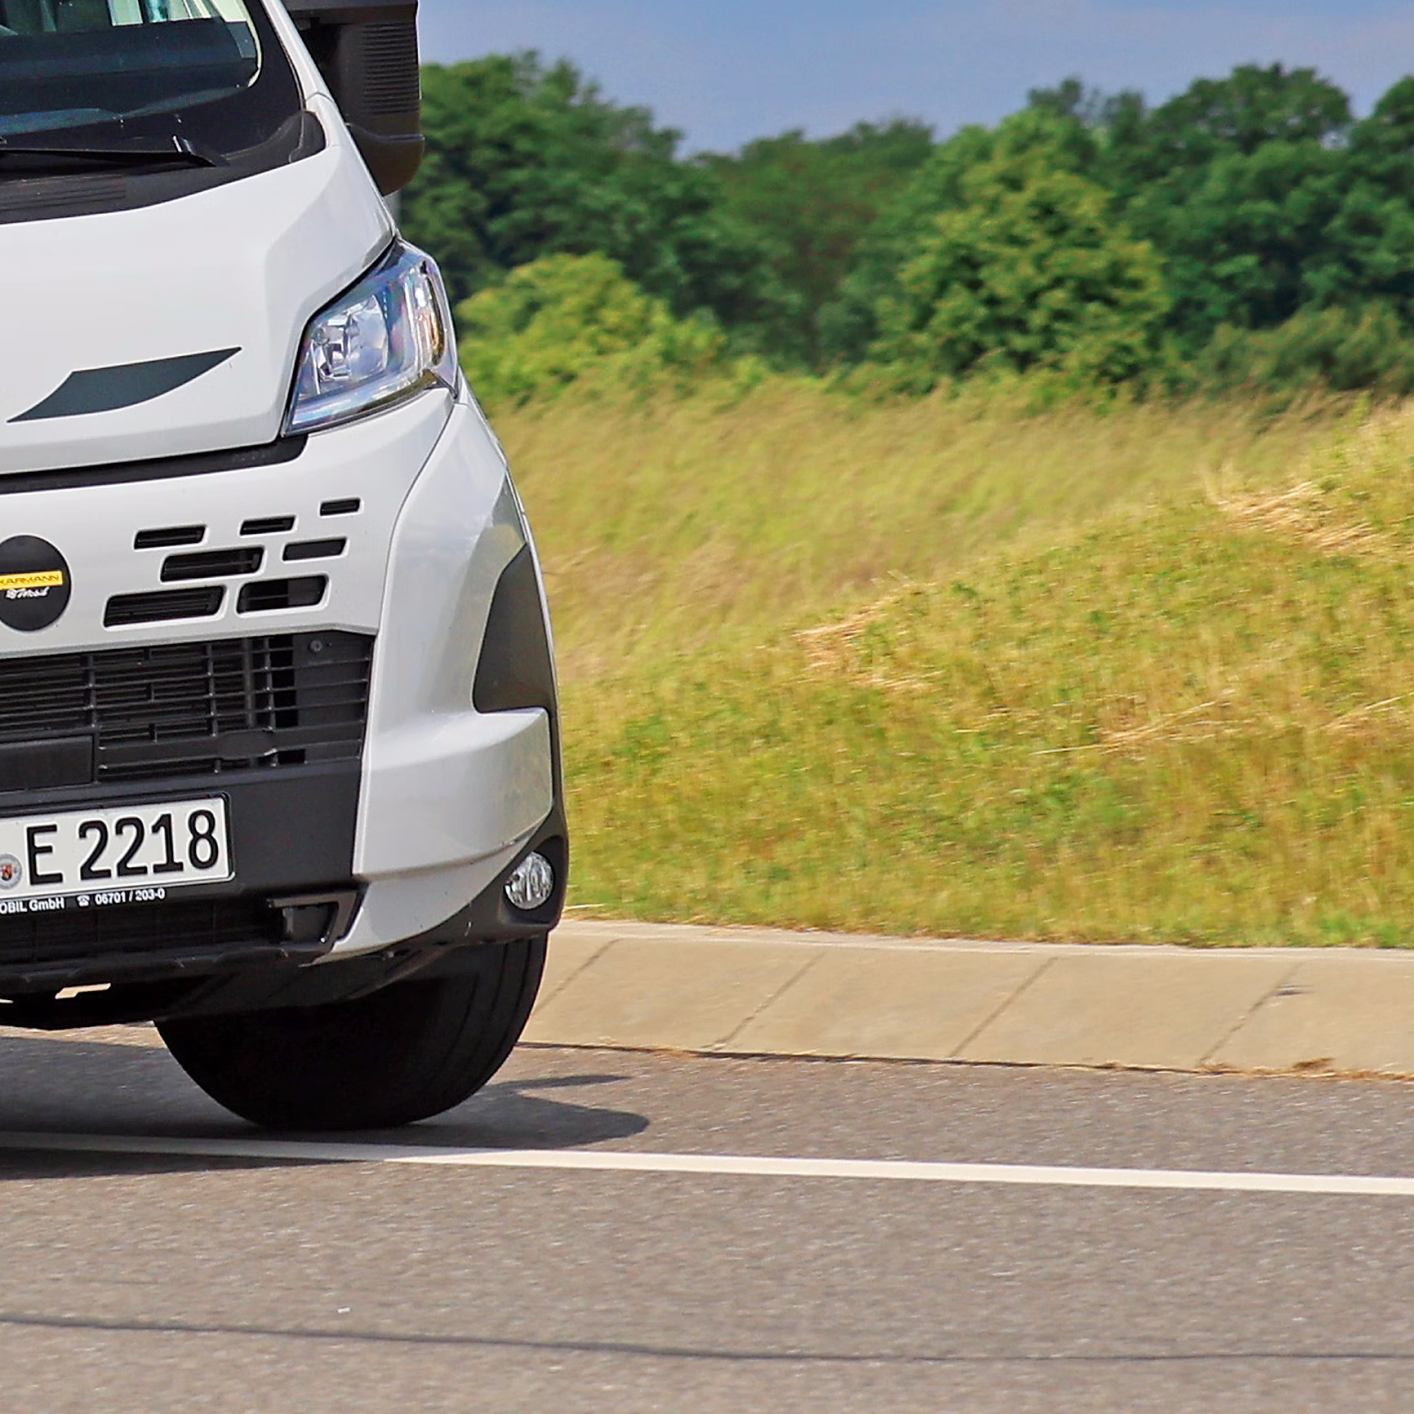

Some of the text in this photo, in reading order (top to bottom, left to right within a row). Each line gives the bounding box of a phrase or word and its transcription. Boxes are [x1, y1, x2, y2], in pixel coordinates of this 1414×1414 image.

[26, 824, 64, 886] E
[78, 809, 219, 881] 2218
[29, 897, 65, 912] GmbH
[95, 892, 127, 905] 06701
